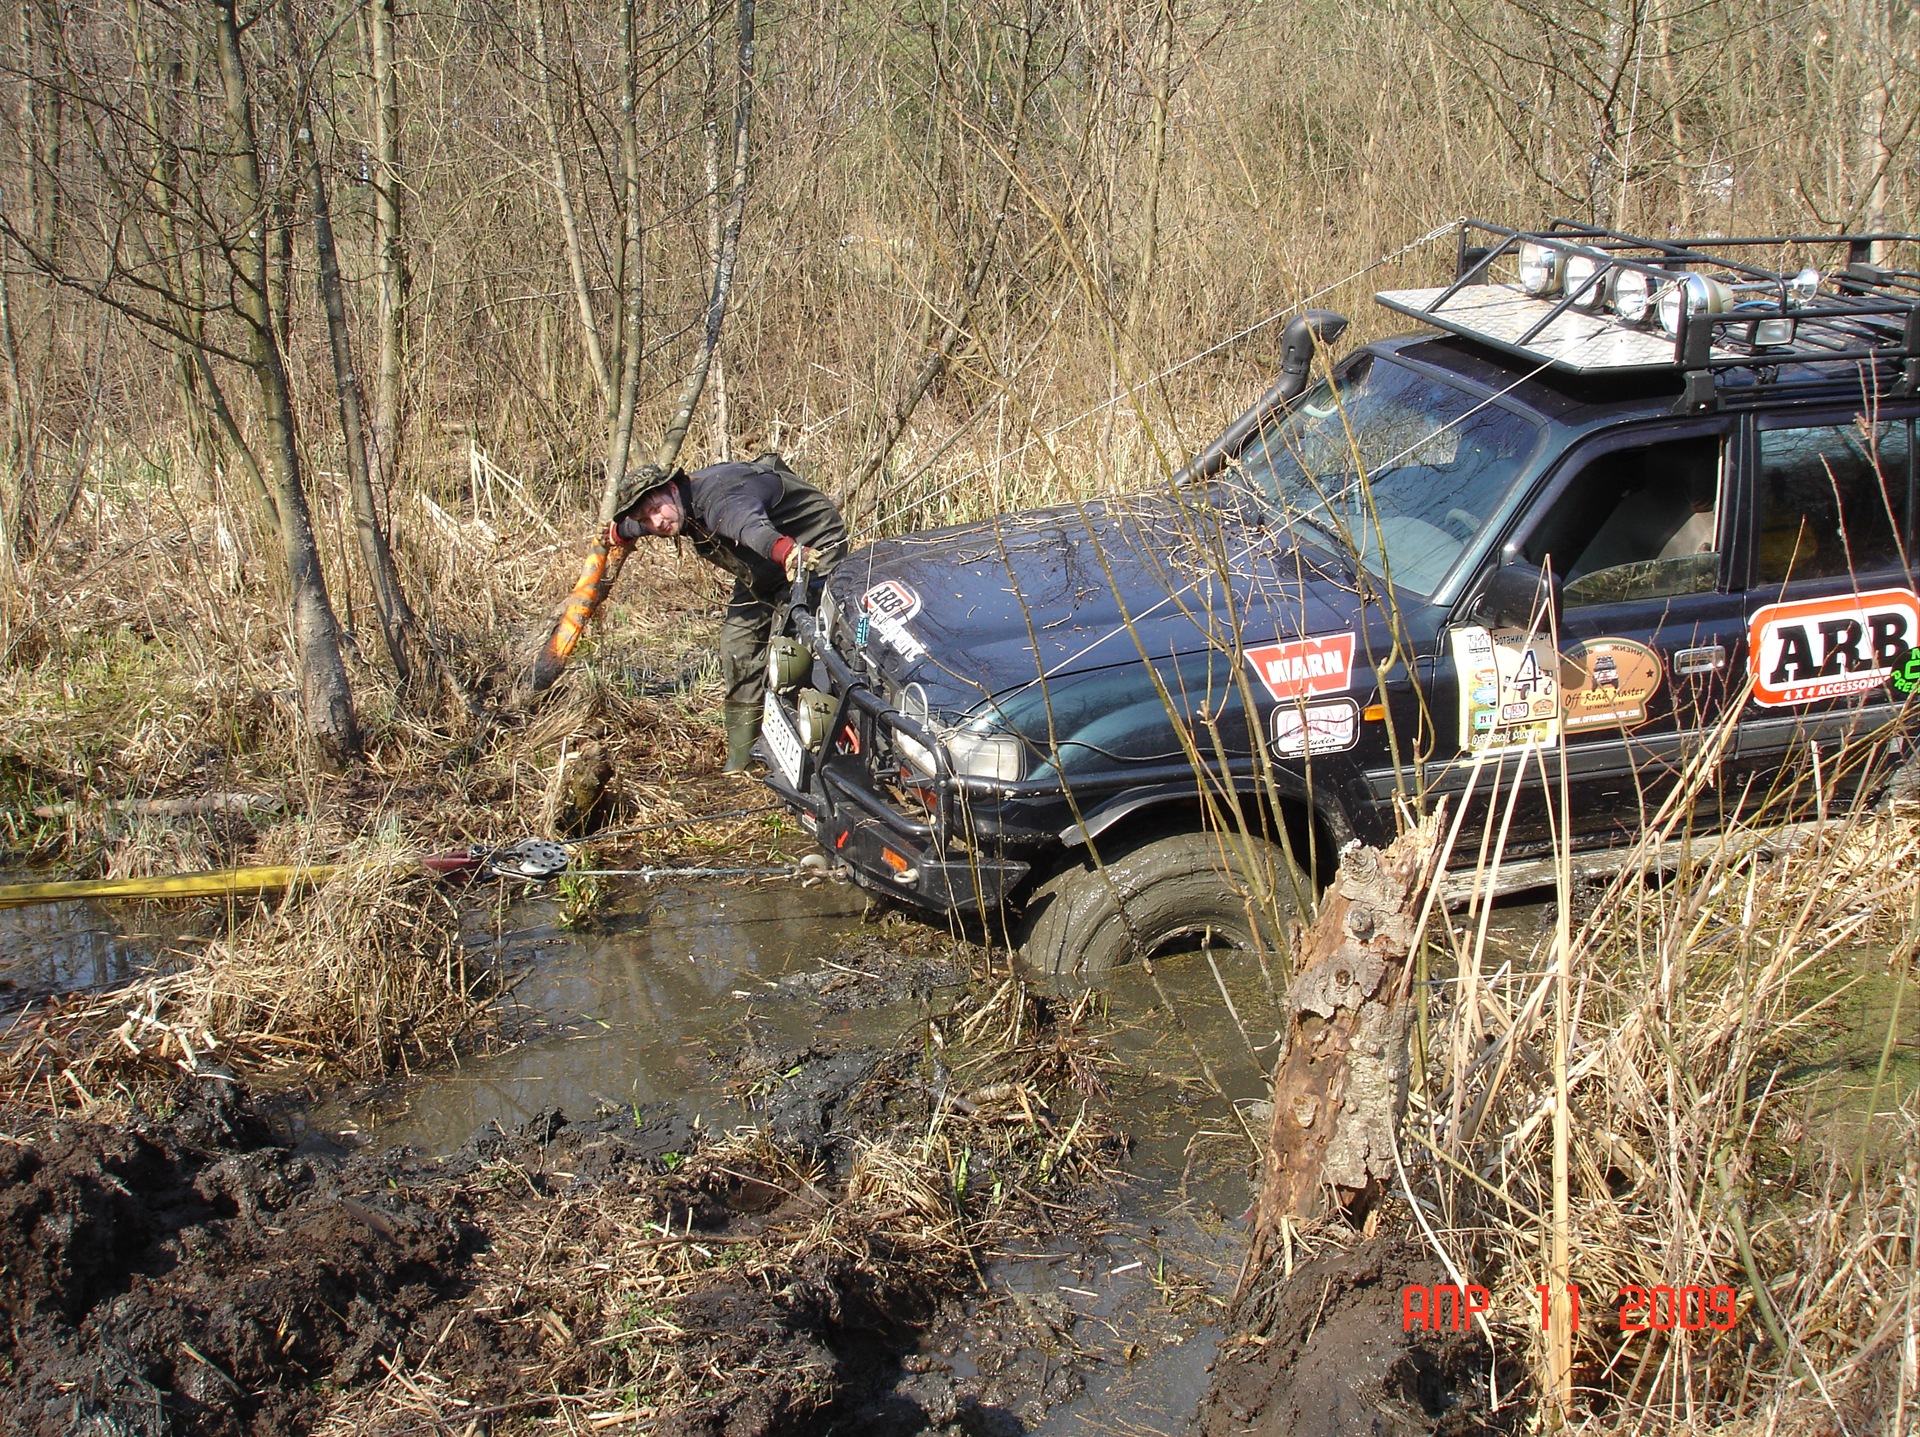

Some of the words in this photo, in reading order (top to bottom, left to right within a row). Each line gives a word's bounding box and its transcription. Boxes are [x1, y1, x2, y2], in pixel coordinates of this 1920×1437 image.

[869, 586, 904, 613] ARB
[1494, 633, 1523, 646] Ботаник
[1611, 644, 1643, 657] ЖИЗНИ
[1770, 613, 1909, 685] ARB
[1266, 650, 1344, 684] WARN
[1514, 649, 1542, 692] 4
[1784, 690, 1791, 700] 4
[1806, 686, 1815, 697] 4
